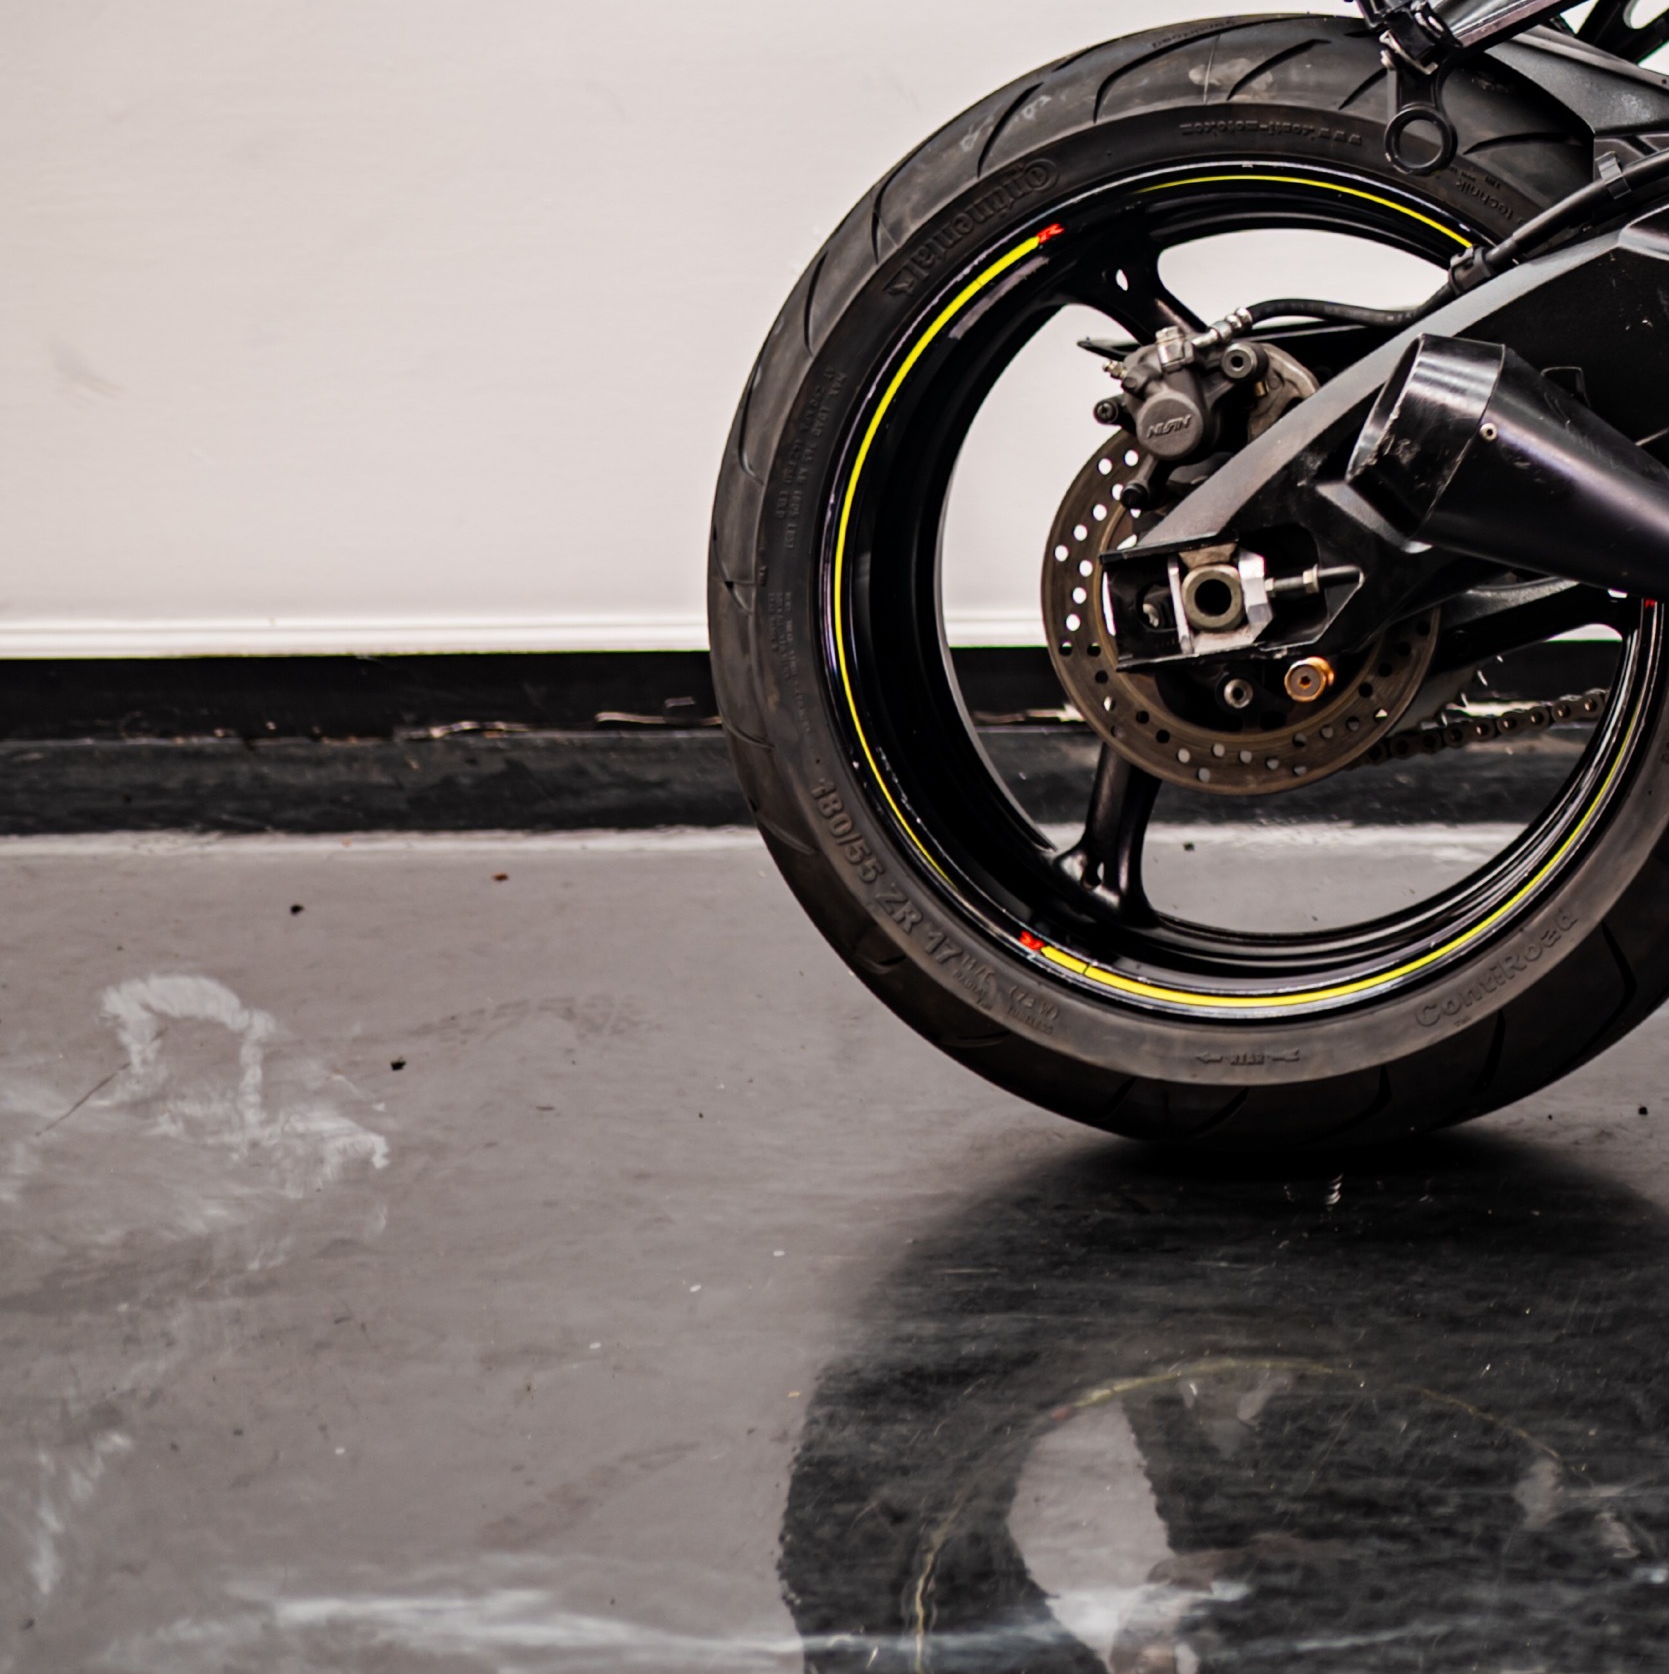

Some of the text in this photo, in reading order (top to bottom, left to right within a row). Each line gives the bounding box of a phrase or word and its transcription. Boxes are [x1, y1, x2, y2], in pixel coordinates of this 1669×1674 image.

[906, 158, 1060, 276] Continental
[810, 776, 886, 885] 180/55
[874, 891, 924, 935] ZR
[924, 931, 963, 966] 17
[1414, 909, 1579, 1028] ContiRoad
